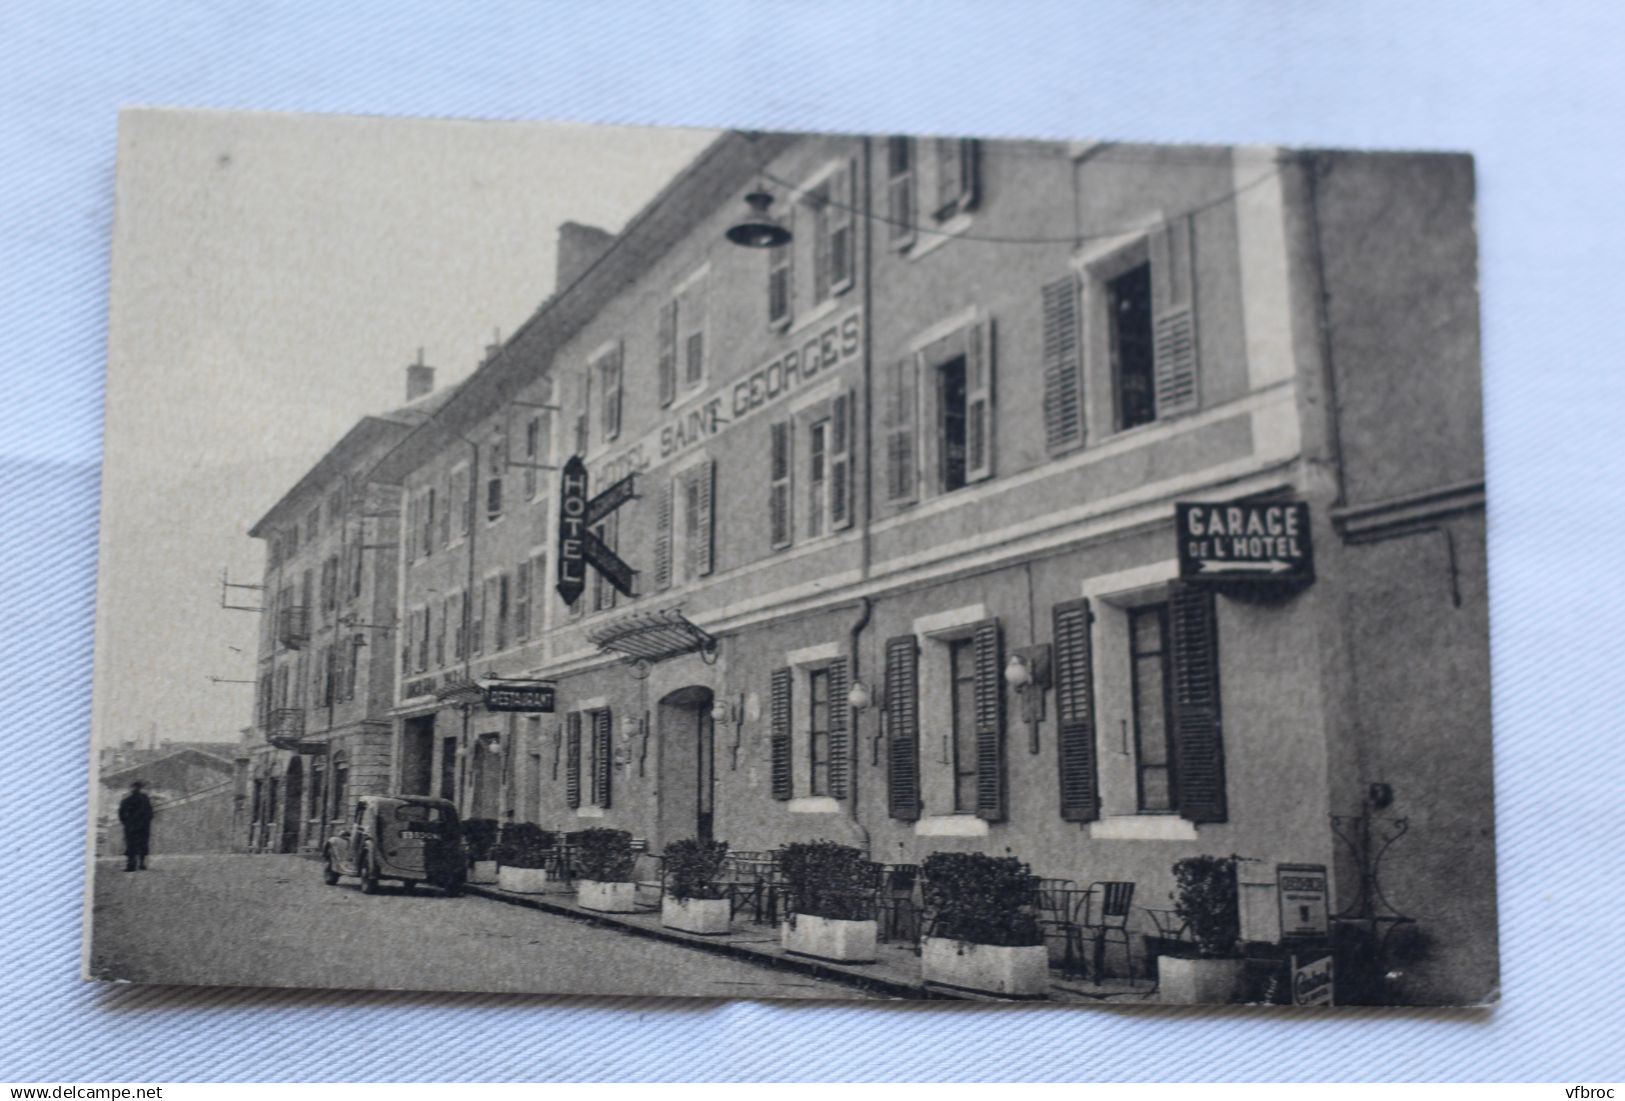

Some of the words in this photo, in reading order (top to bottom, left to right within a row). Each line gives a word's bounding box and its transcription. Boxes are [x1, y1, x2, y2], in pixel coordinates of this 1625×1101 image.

[661, 397, 721, 458] SAINT
[733, 315, 860, 418] GEORGES
[563, 474, 585, 582] HOTEL
[1188, 507, 1298, 535] GARAGE
[1189, 541, 1208, 557] DE
